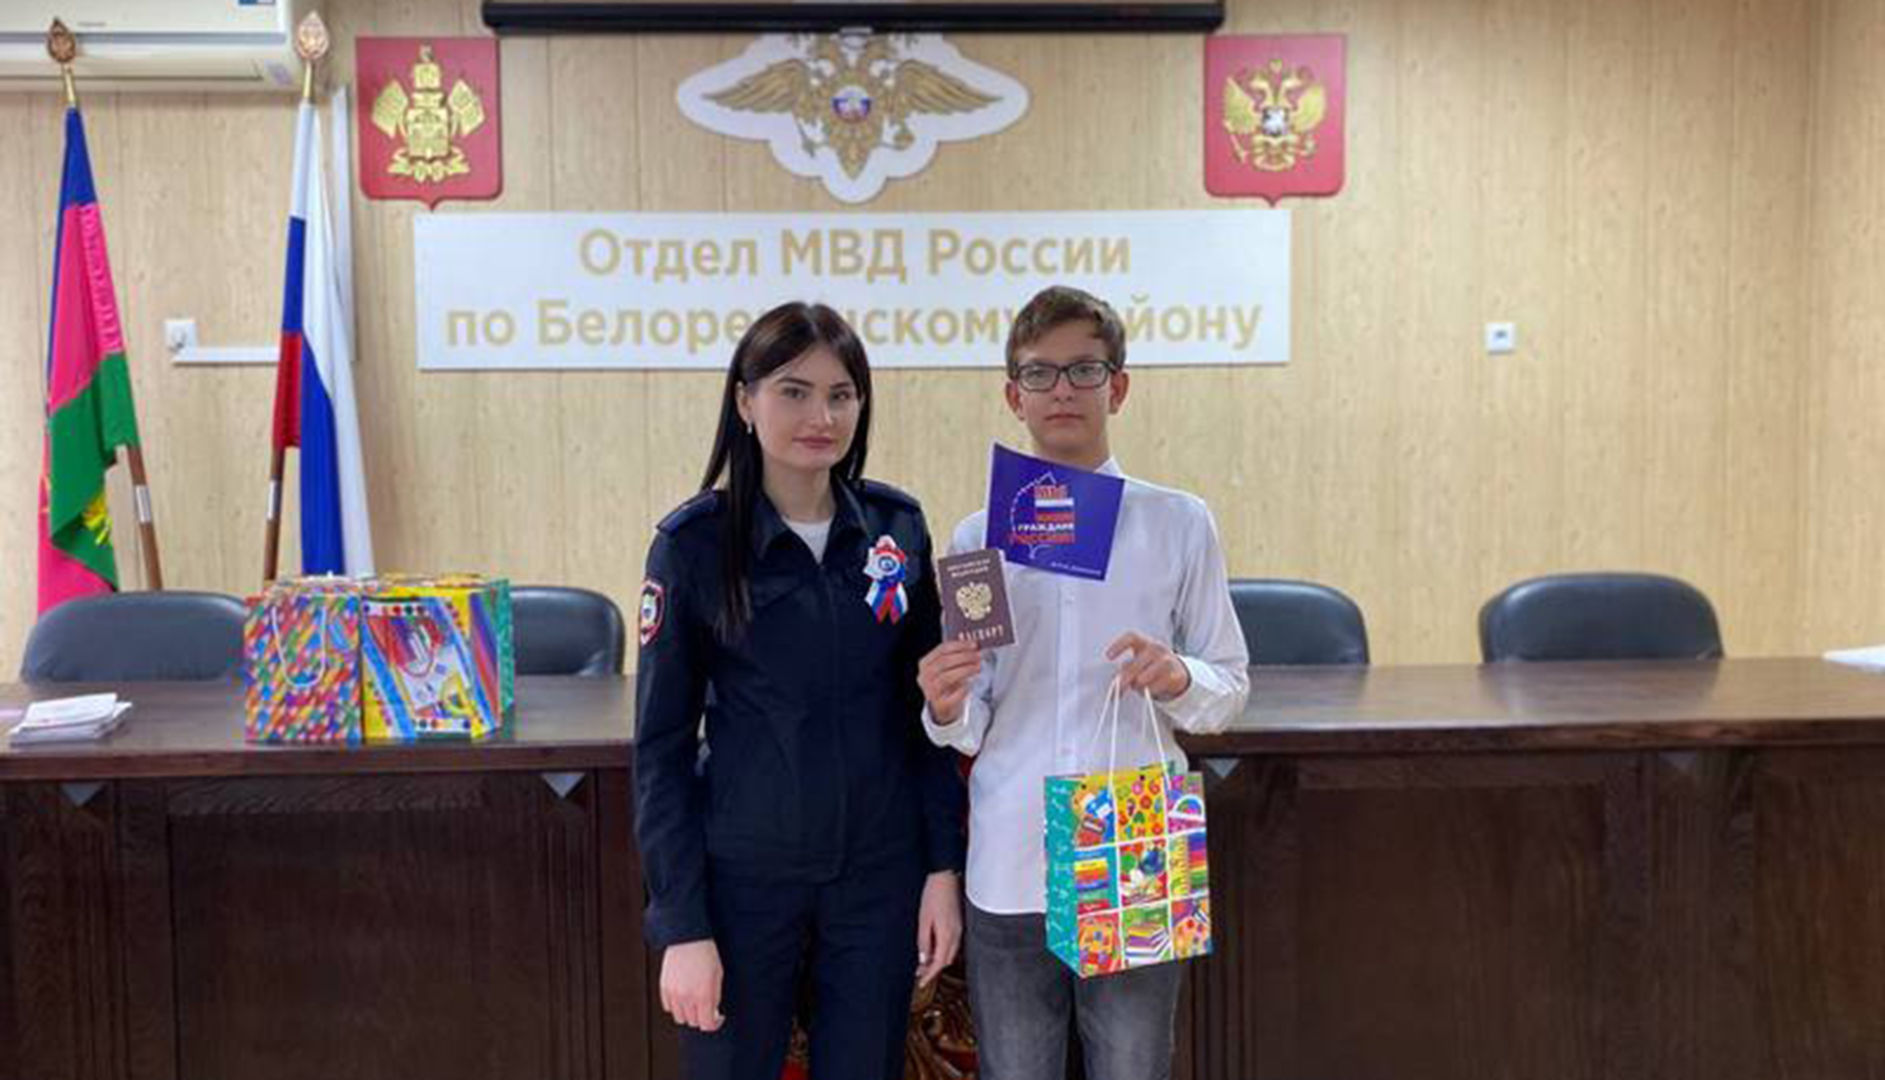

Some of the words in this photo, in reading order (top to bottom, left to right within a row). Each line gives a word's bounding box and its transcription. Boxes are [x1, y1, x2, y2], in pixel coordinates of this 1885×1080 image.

[579, 228, 758, 283] Отдел
[780, 228, 907, 284] МВД
[928, 228, 1131, 277] России
[446, 310, 516, 347] по
[1126, 294, 1262, 350] йону
